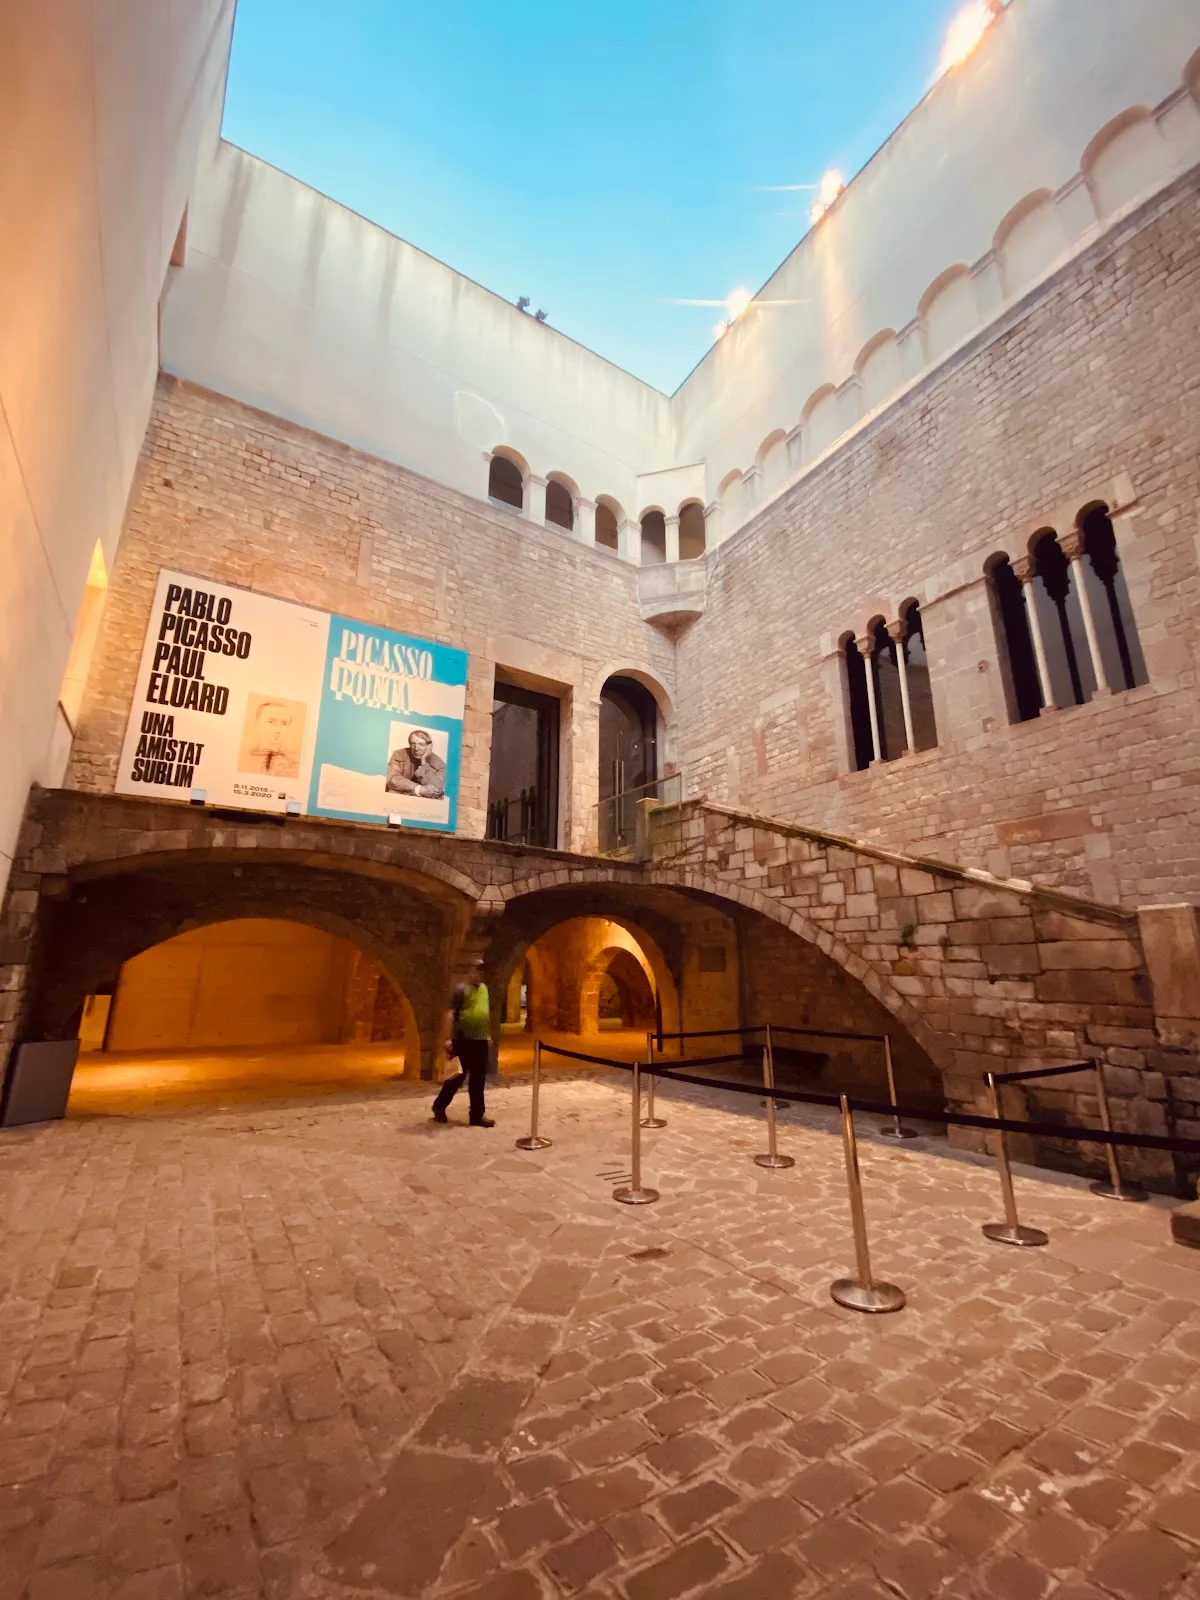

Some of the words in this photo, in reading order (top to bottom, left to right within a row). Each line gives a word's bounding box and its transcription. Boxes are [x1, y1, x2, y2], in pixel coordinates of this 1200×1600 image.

[164, 583, 232, 625] PABLO
[158, 612, 252, 659] PICASSO
[340, 629, 432, 682] PICASSO
[152, 641, 206, 681] PAUL
[146, 672, 229, 715] ELUARD
[140, 711, 174, 738] UNA
[135, 734, 204, 766] AMISTAT
[131, 758, 194, 788] SUBLIM
